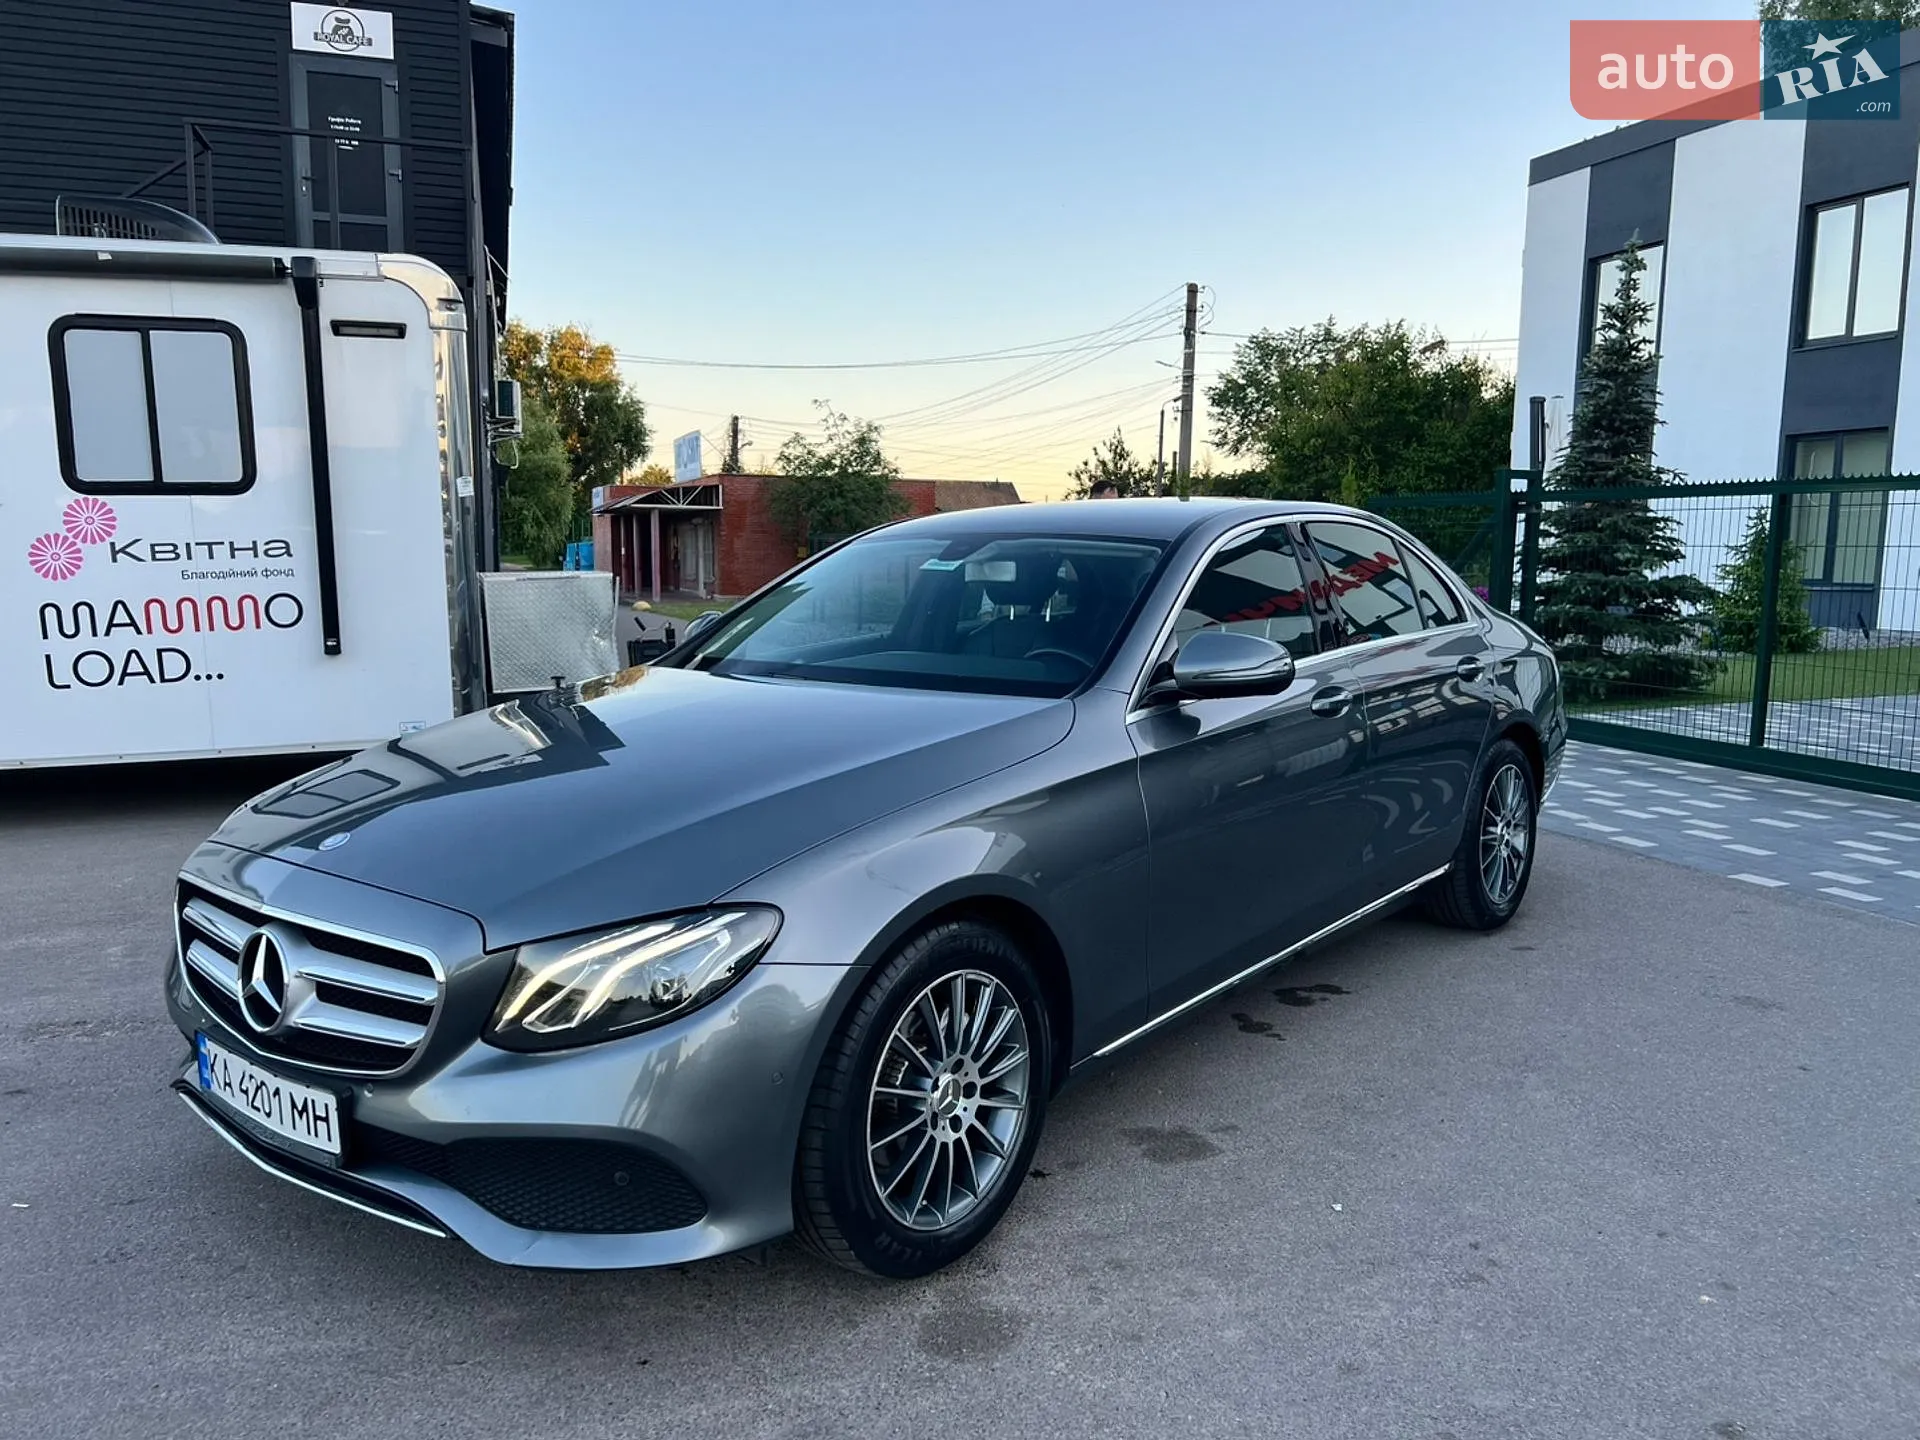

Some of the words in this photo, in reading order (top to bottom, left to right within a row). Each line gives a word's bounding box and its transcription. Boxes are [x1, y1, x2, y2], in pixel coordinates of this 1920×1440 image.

[317, 32, 345, 43] ROYAL
[181, 567, 258, 581] Благодійний
[261, 566, 295, 580] фонд
[39, 593, 303, 640] MAMMO
[208, 1049, 234, 1097] KA
[239, 1071, 283, 1125] 4201
[290, 1092, 332, 1143] MH
